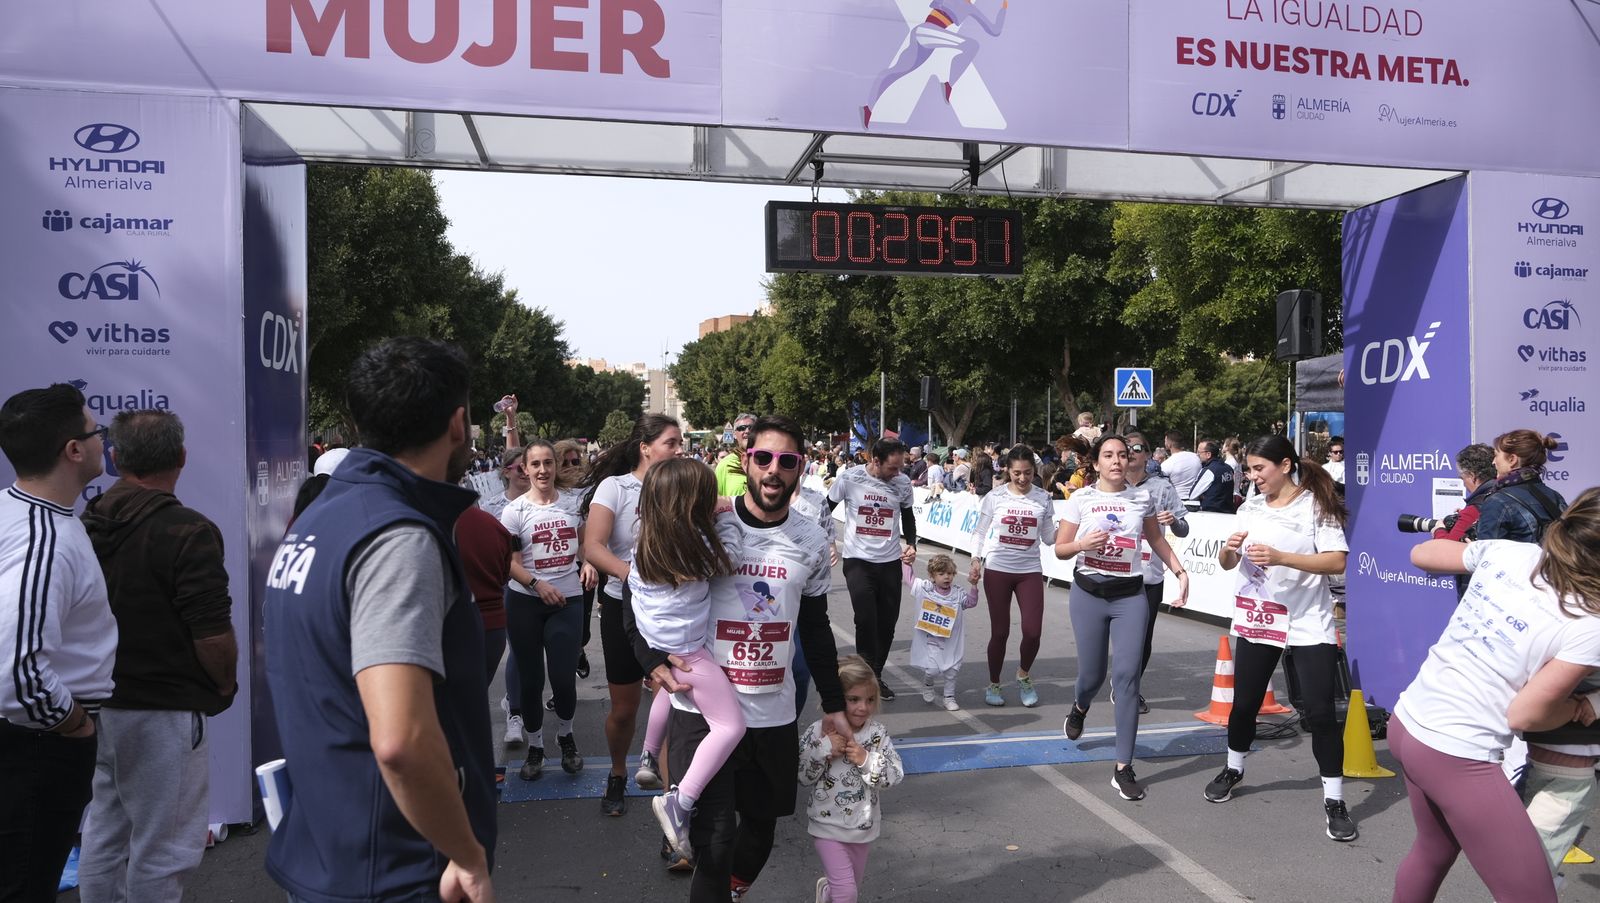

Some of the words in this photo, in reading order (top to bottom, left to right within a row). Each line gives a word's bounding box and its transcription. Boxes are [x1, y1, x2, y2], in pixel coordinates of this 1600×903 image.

[1227, 0, 1263, 22] LA
[1274, 0, 1423, 37] IGUALDAD
[266, 0, 670, 78] MUJER
[1176, 36, 1216, 66] ES
[1225, 40, 1371, 80] NUESTRA
[1378, 54, 1470, 87] META.
[1192, 90, 1243, 118] CDX
[1297, 97, 1351, 113] ALMERÍA
[1297, 111, 1325, 121] CIUDAD
[49, 157, 165, 174] HYUNDAI
[65, 176, 152, 191] Almerialva
[80, 213, 173, 234] cajamar
[1518, 222, 1584, 235] HYUNDAI
[1527, 236, 1577, 247] Almerialva
[1535, 264, 1589, 279] cajamar
[58, 271, 139, 300] CASI
[1523, 307, 1569, 330] CASI
[86, 323, 171, 343] vithas
[260, 311, 302, 375] CDX
[86, 347, 107, 356] vivir
[108, 348, 130, 357] para
[131, 347, 171, 356] cuidarte
[1361, 324, 1441, 386] CDX
[1538, 347, 1587, 362] vithas
[87, 389, 169, 415] qualia
[1529, 397, 1585, 416] aqualia
[1380, 450, 1452, 470] ALMERÍA
[1380, 473, 1414, 484] CIUDAD
[863, 494, 888, 502] MUJER
[1091, 505, 1126, 513] MUJER
[534, 520, 567, 531] MUJER
[865, 515, 885, 526] 896
[1008, 524, 1028, 535] 895
[543, 540, 569, 553] 765
[735, 563, 787, 580] MUJER
[1183, 559, 1216, 575] CIUDAD
[922, 611, 951, 628] BEBÉ
[1246, 610, 1275, 625] 949
[732, 642, 774, 662] 652
